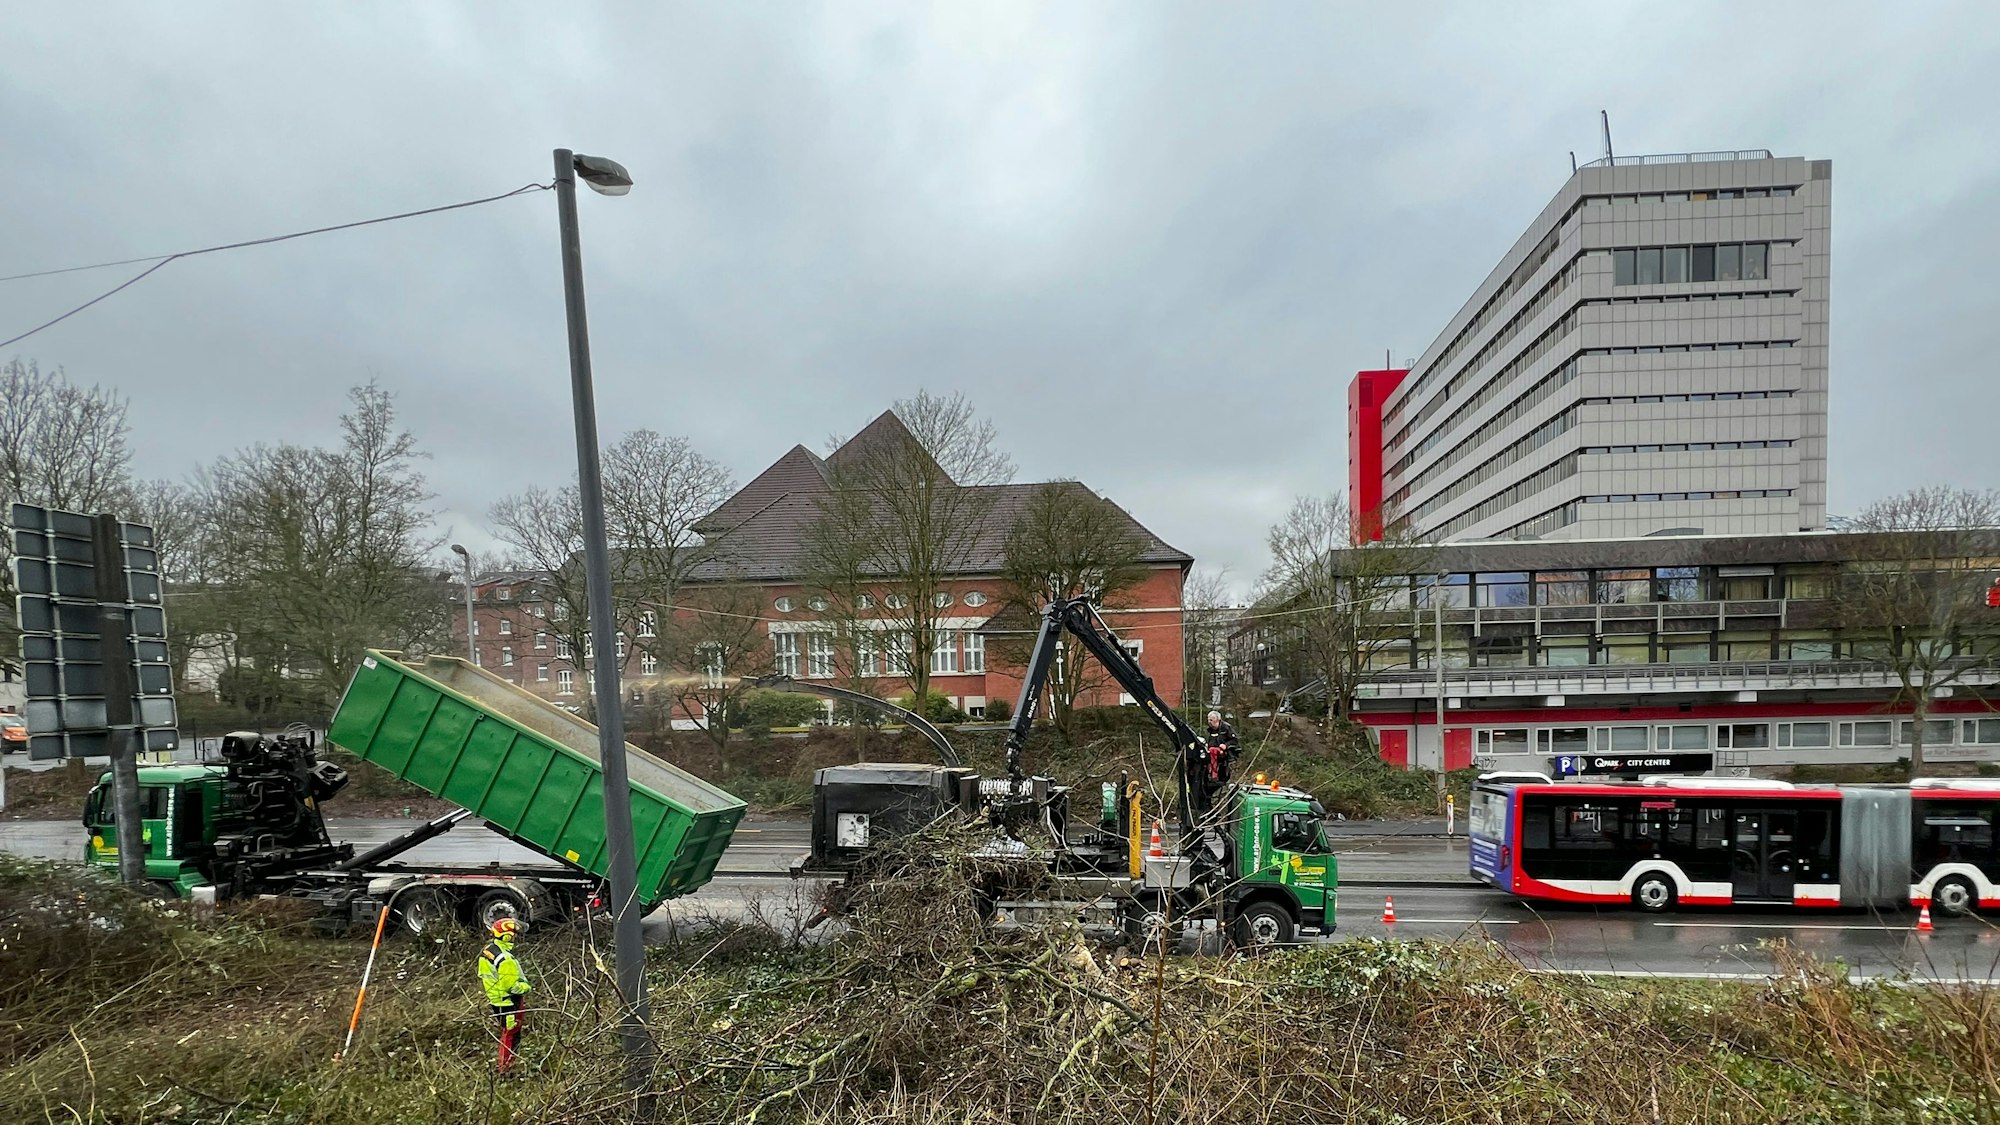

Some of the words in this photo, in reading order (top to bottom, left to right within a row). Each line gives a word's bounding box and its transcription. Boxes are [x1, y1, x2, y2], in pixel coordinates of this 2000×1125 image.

[1627, 759, 1643, 767] CITY
[1644, 758, 1671, 767] CENTER
[165, 788, 175, 857] www.arbor-care.eu
